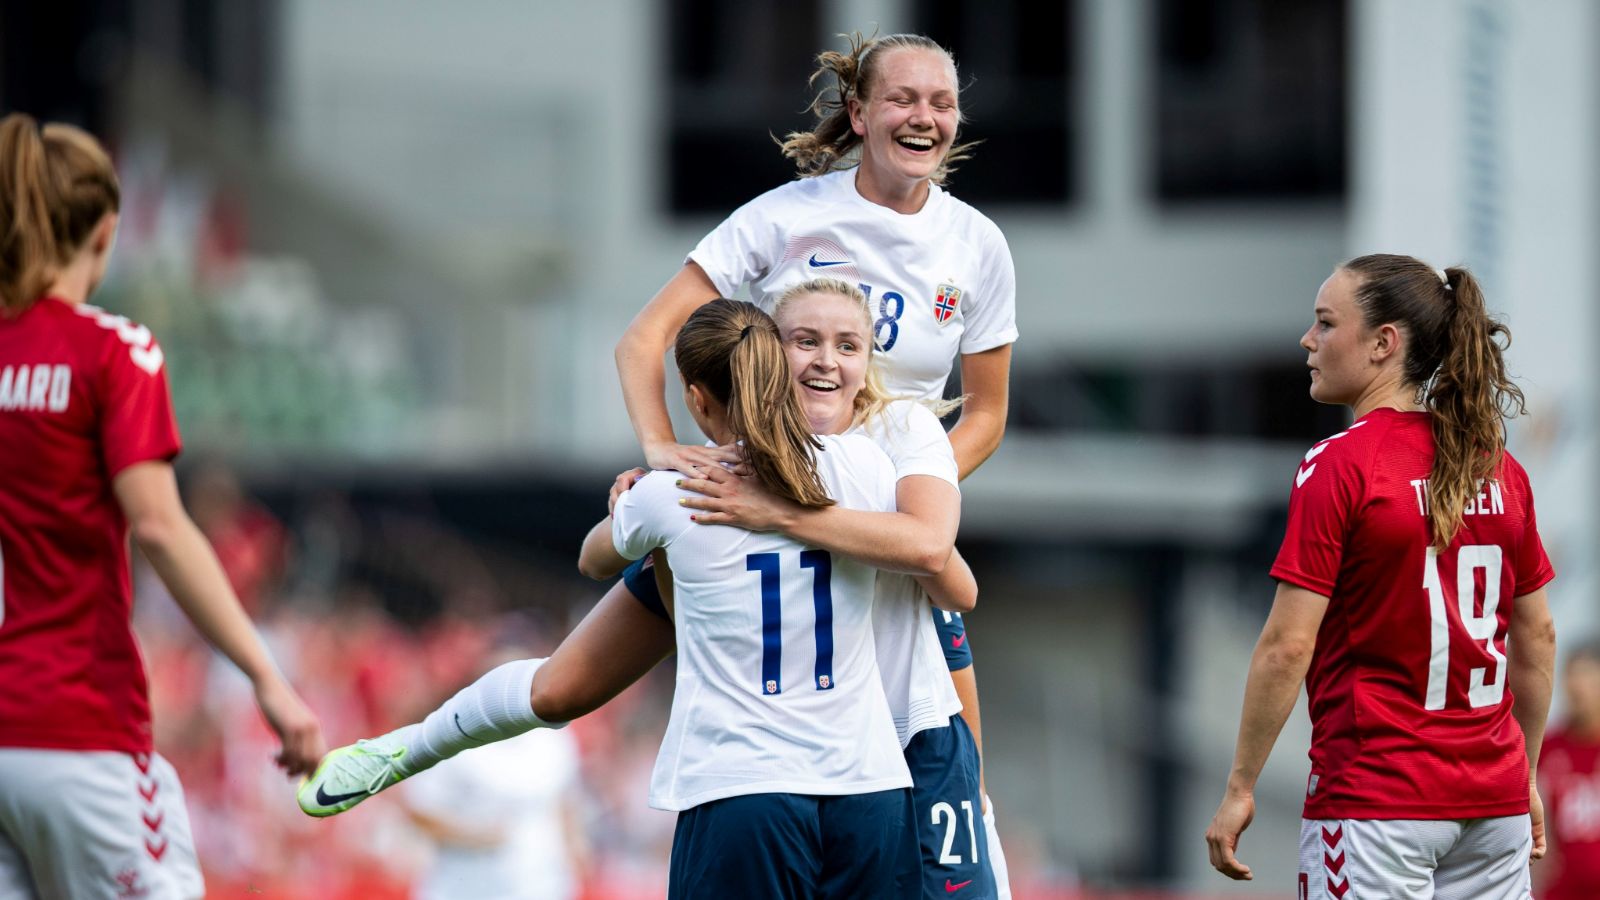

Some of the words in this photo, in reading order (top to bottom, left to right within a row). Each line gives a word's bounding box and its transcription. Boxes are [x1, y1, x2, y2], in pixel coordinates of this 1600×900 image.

[746, 550, 834, 695] 11
[1422, 545, 1507, 711] 19
[931, 801, 978, 864] 21
